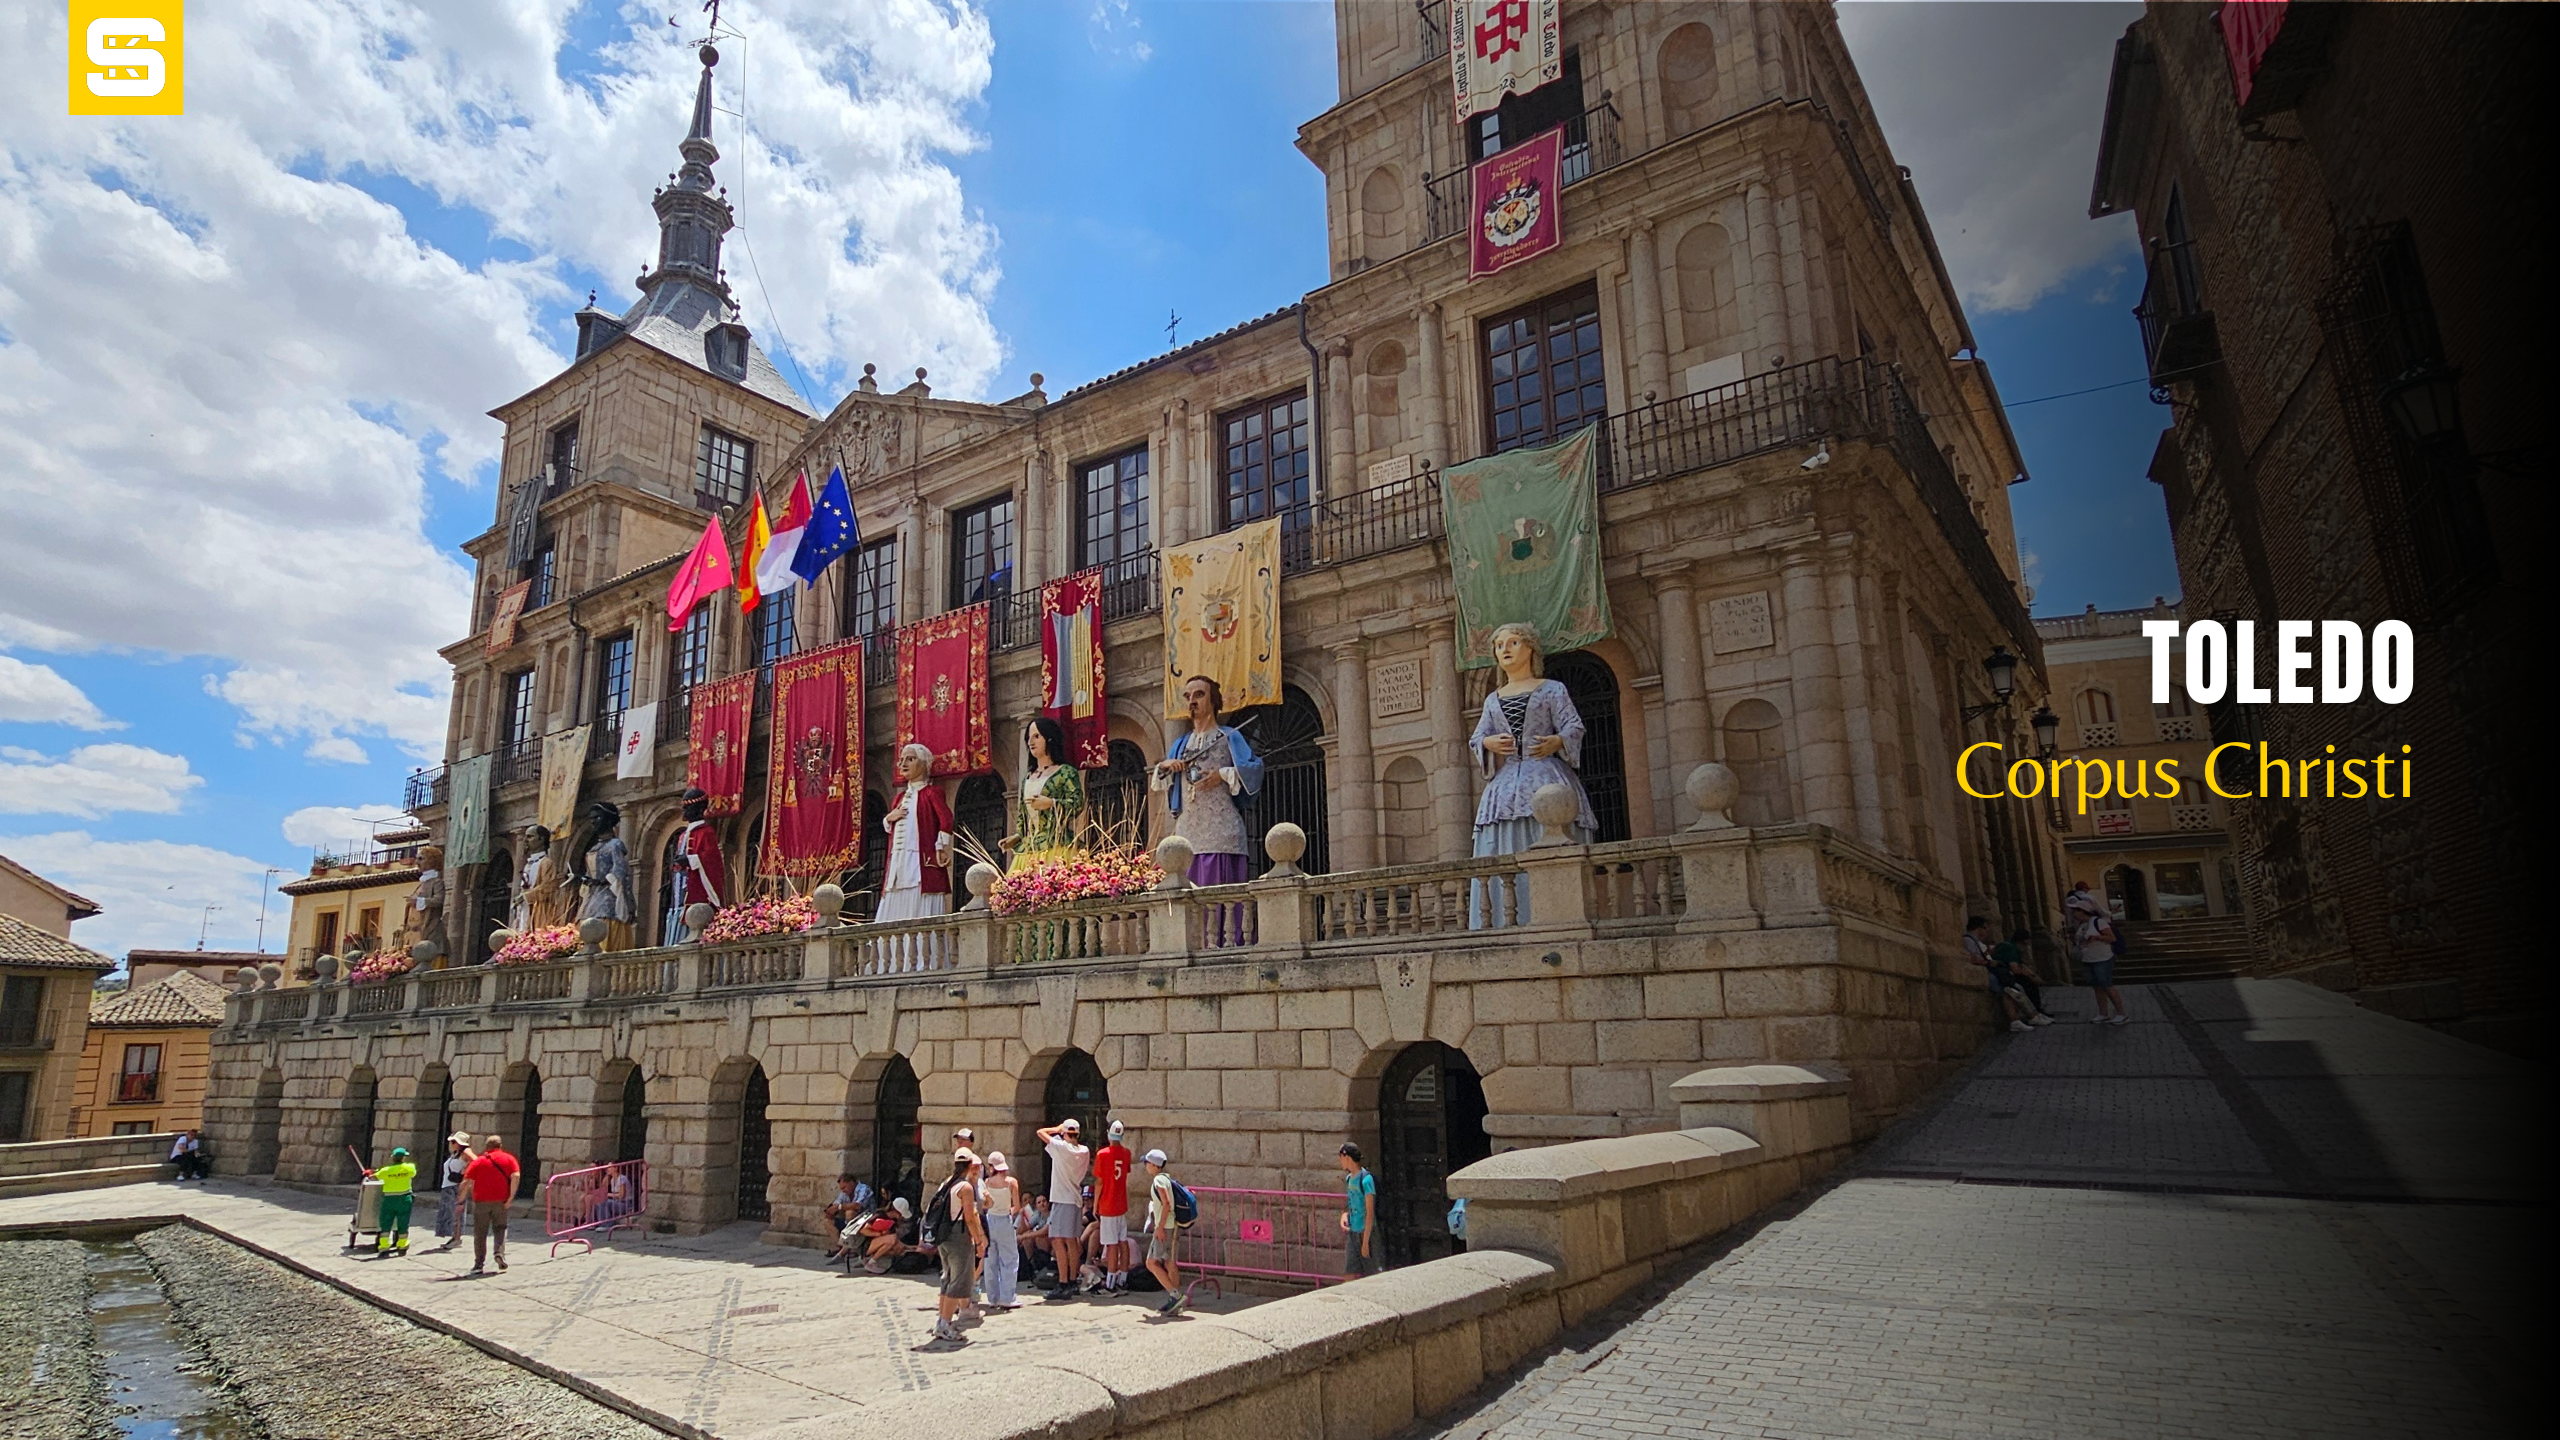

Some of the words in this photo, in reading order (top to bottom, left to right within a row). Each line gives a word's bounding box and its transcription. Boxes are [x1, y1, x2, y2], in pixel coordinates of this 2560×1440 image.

[1543, 5, 1555, 20] de
[1543, 20, 1557, 58] Toledo
[1455, 51, 1465, 63] de
[1114, 1160, 1123, 1180] 5
